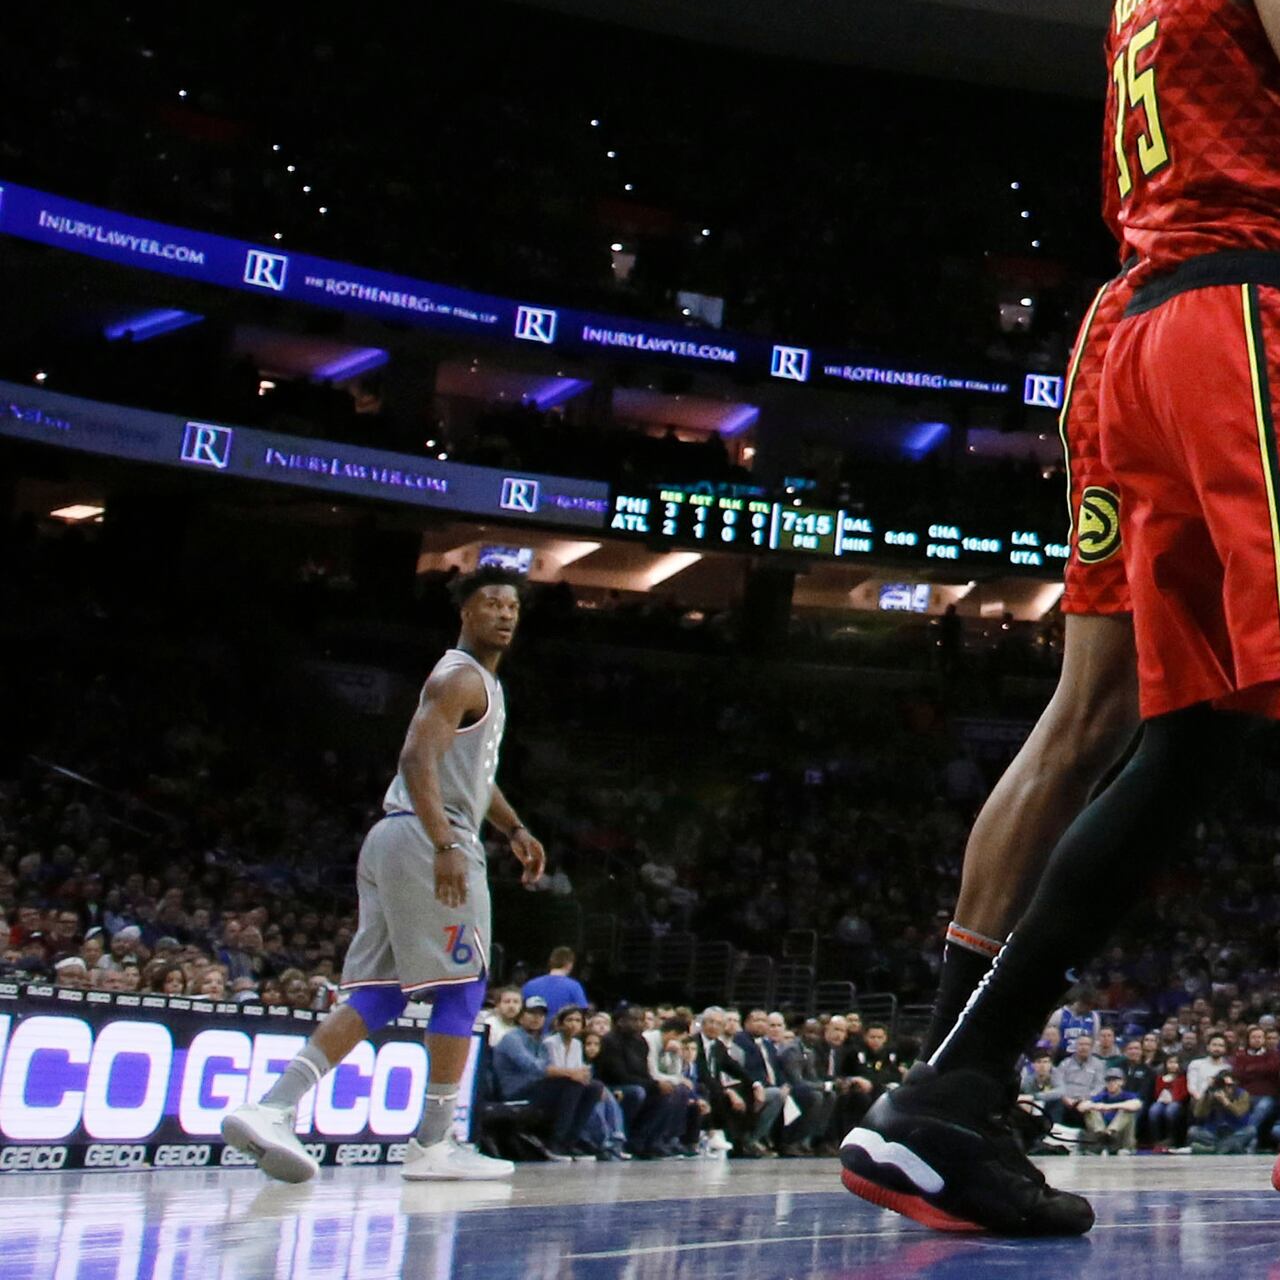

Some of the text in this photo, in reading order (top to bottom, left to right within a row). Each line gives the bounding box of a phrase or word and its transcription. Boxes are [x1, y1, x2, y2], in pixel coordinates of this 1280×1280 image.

[1112, 20, 1169, 199] 15
[615, 495, 651, 515] PHI
[664, 502, 680, 518] 3
[694, 506, 708, 522] 1
[723, 509, 738, 525] 0
[752, 512, 767, 529] 0
[781, 510, 834, 535] 7:15
[611, 512, 765, 546] ATL 2 1 0 1
[927, 524, 961, 540] CHA
[1011, 530, 1041, 546] LAL
[792, 533, 819, 550] PM
[926, 544, 960, 560] POR
[961, 537, 1002, 553] 10:00
[1009, 550, 1043, 566] UTA
[443, 924, 474, 965] 76
[0, 1014, 175, 1140] CO
[178, 1028, 429, 1137] GECO
[1, 1146, 67, 1170] GEICO
[84, 1144, 145, 1167] GEICO
[154, 1144, 210, 1167] GEICO
[335, 1143, 381, 1165] GEICO
